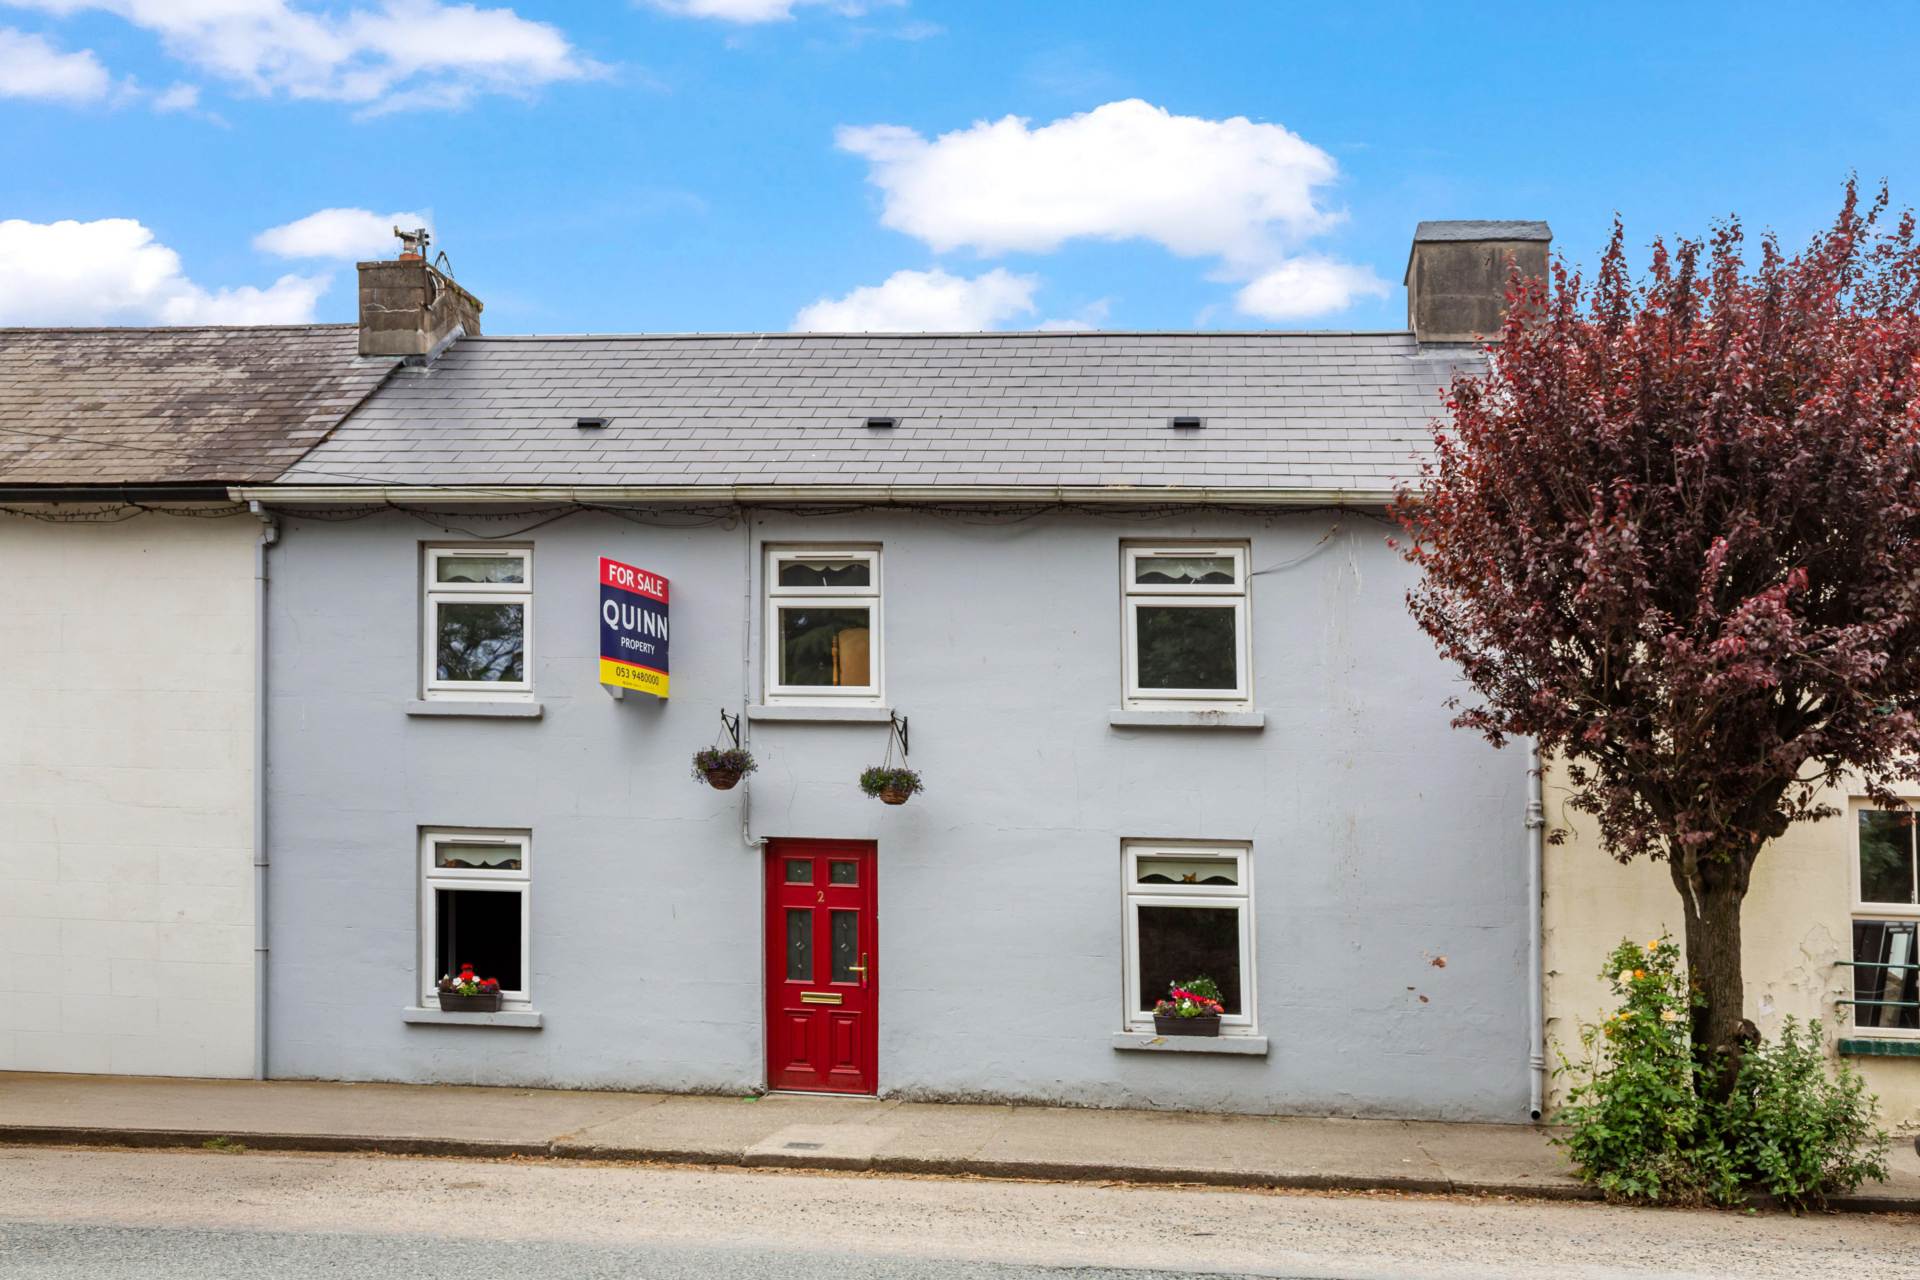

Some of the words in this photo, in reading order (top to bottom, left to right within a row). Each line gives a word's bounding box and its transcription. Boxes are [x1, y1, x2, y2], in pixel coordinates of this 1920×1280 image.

[609, 564, 634, 588] FOR
[638, 573, 663, 597] SALE
[603, 599, 668, 641] QUINN
[620, 636, 655, 655] PROPERTY
[616, 666, 630, 679] 053
[631, 670, 660, 686] 9480000
[817, 890, 825, 903] 2
